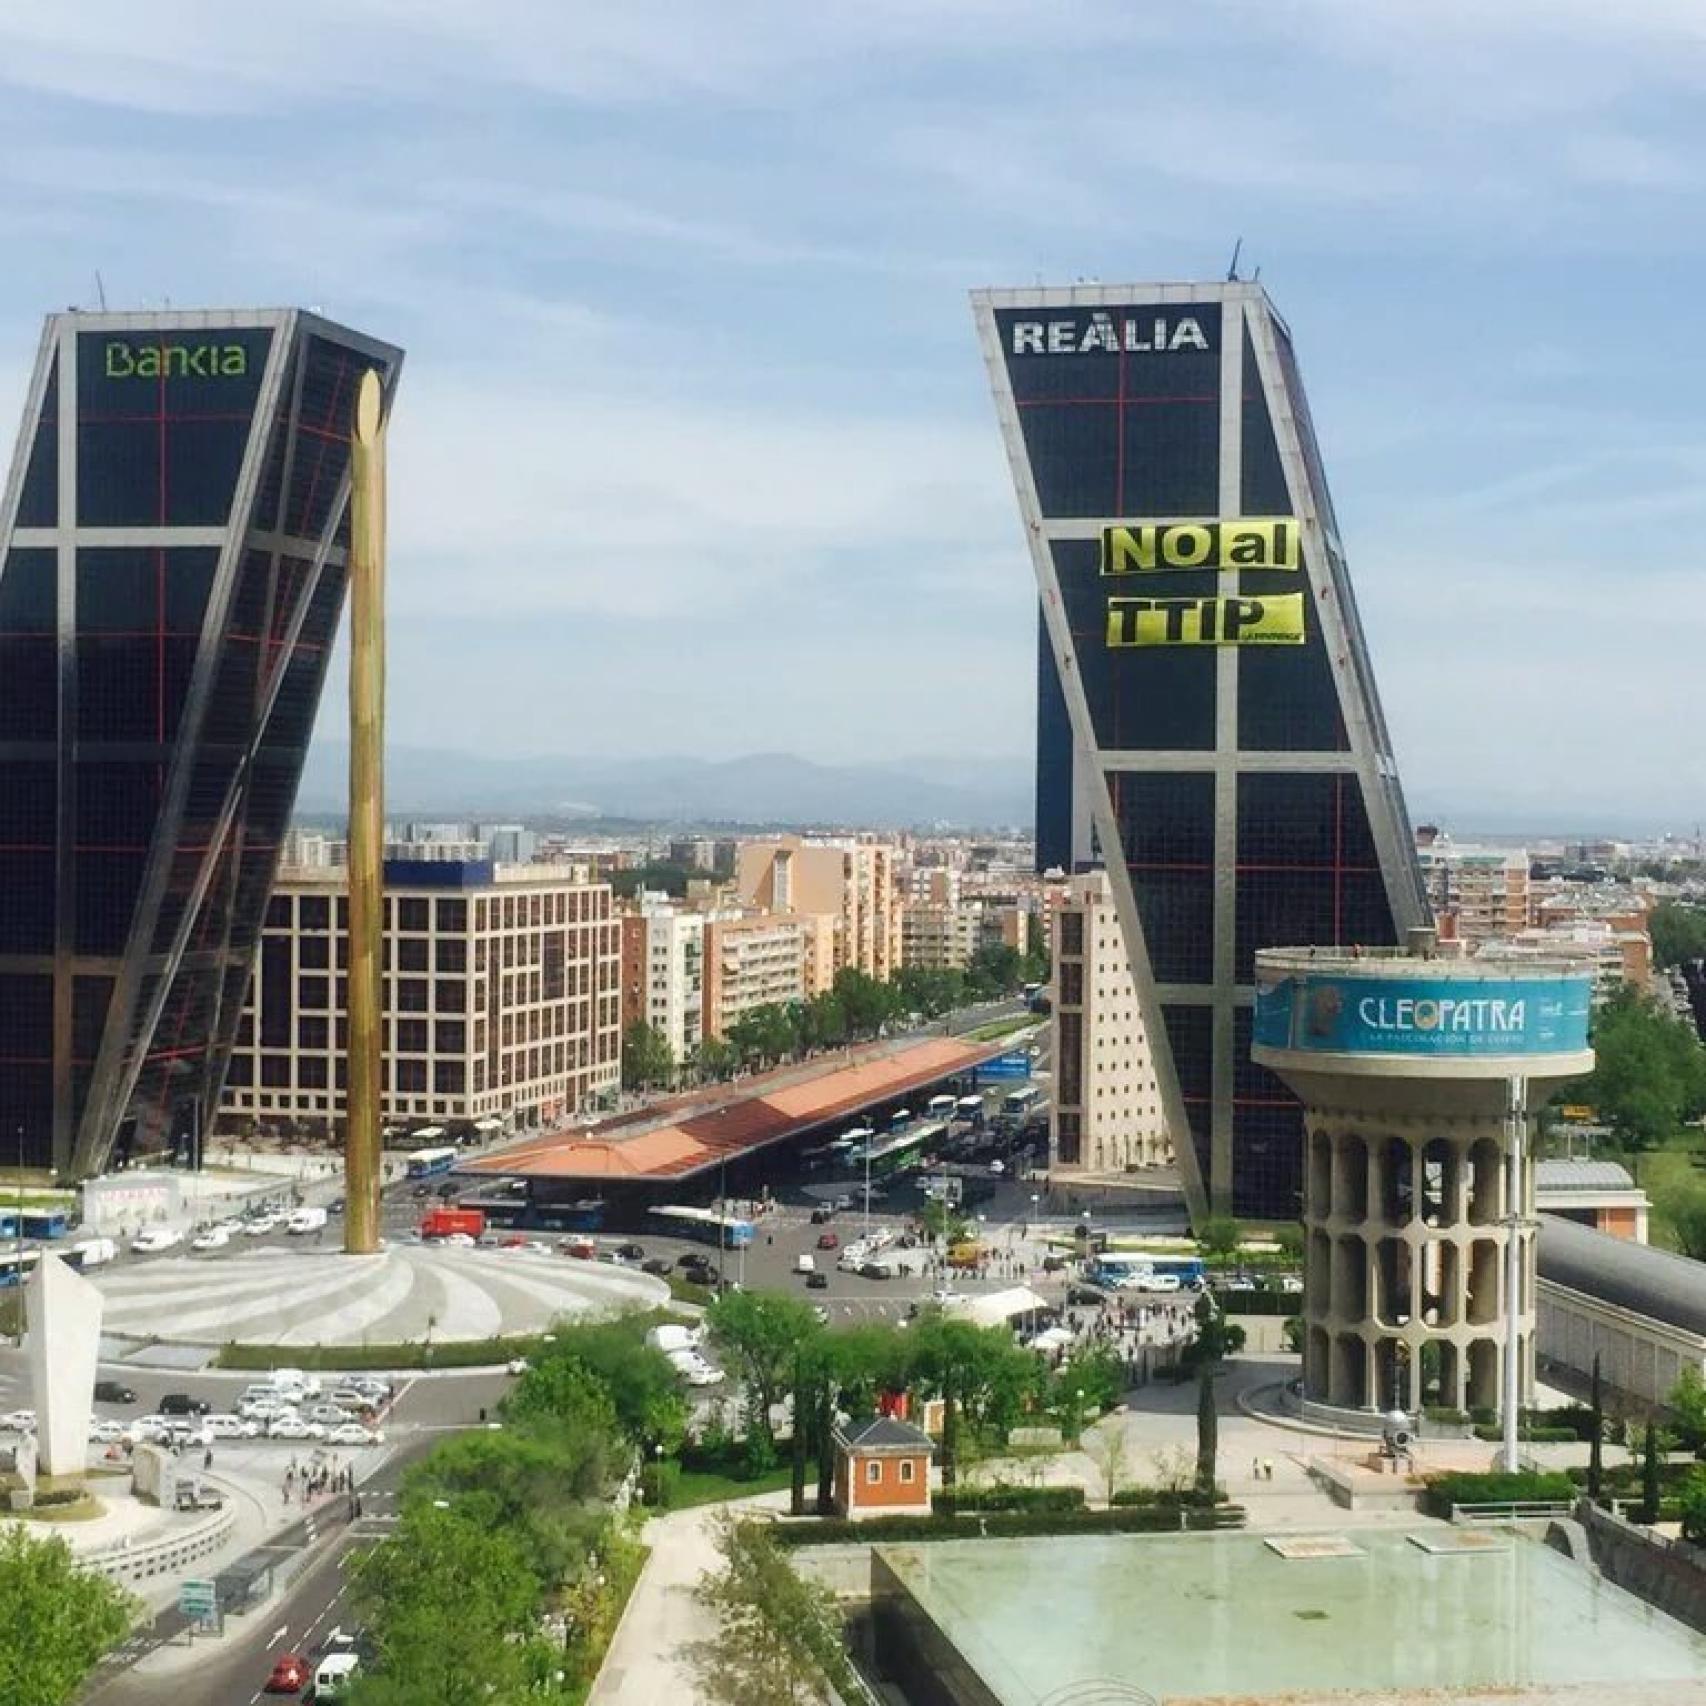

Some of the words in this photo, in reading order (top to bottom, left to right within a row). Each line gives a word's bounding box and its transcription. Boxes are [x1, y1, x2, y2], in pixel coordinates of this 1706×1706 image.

[105, 343, 247, 378] Bankia
[1112, 525, 1212, 570] NO
[1230, 524, 1287, 565] al
[1110, 601, 1265, 642] TTIP
[1359, 997, 1525, 1032] CLEOPATRA
